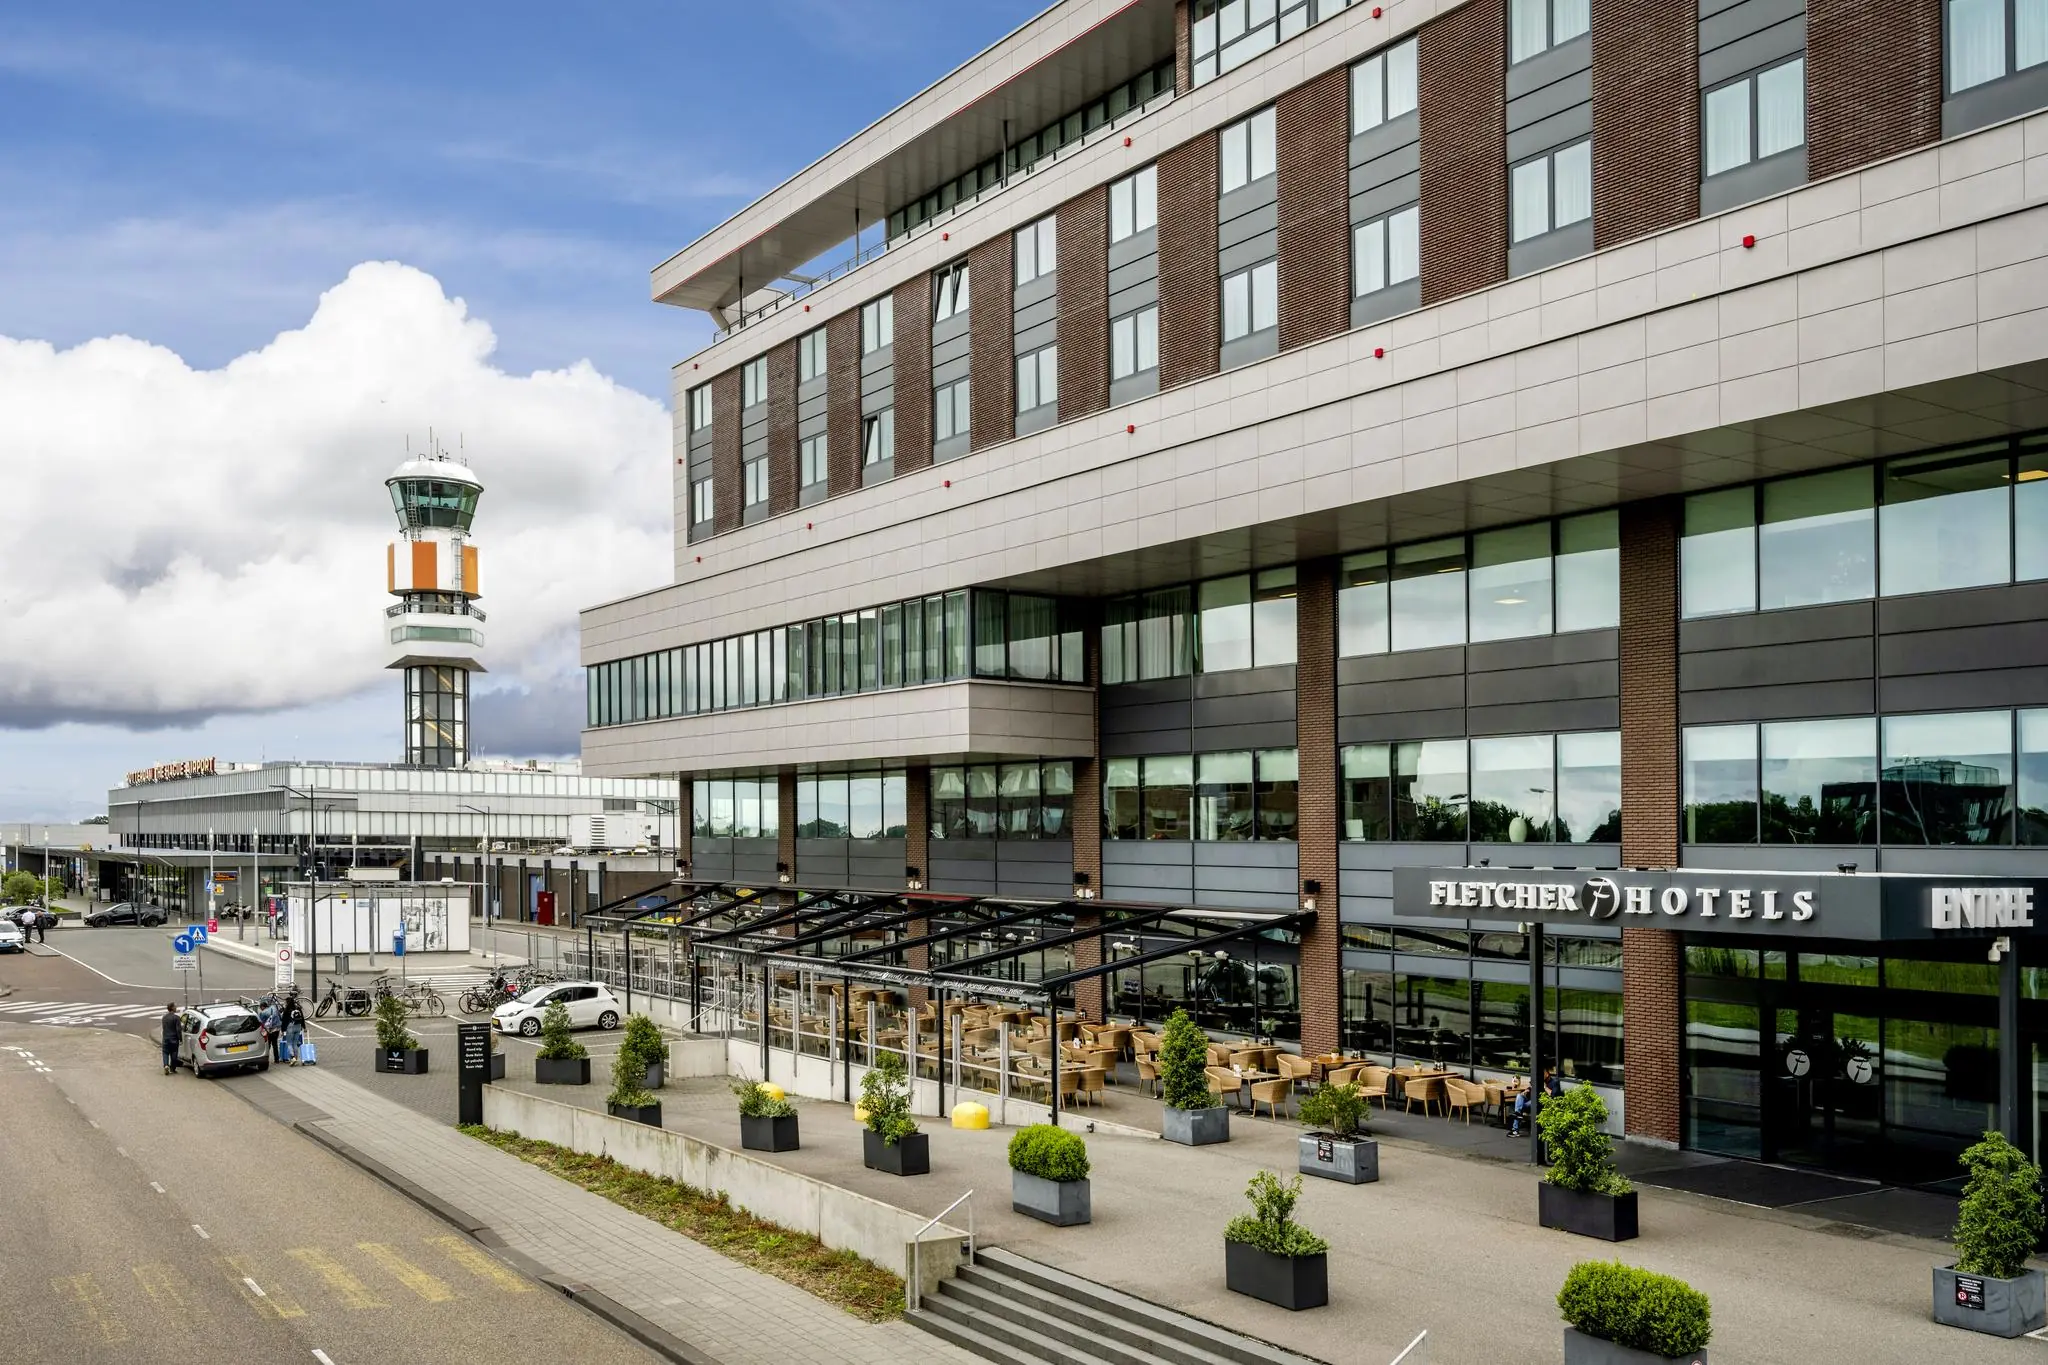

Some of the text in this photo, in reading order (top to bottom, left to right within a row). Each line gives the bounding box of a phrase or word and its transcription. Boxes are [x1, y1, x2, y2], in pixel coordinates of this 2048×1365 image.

[1429, 881, 1579, 911] FLETCHER
[1624, 887, 1813, 920] HOTELS
[1932, 888, 2033, 928] ENTREE
